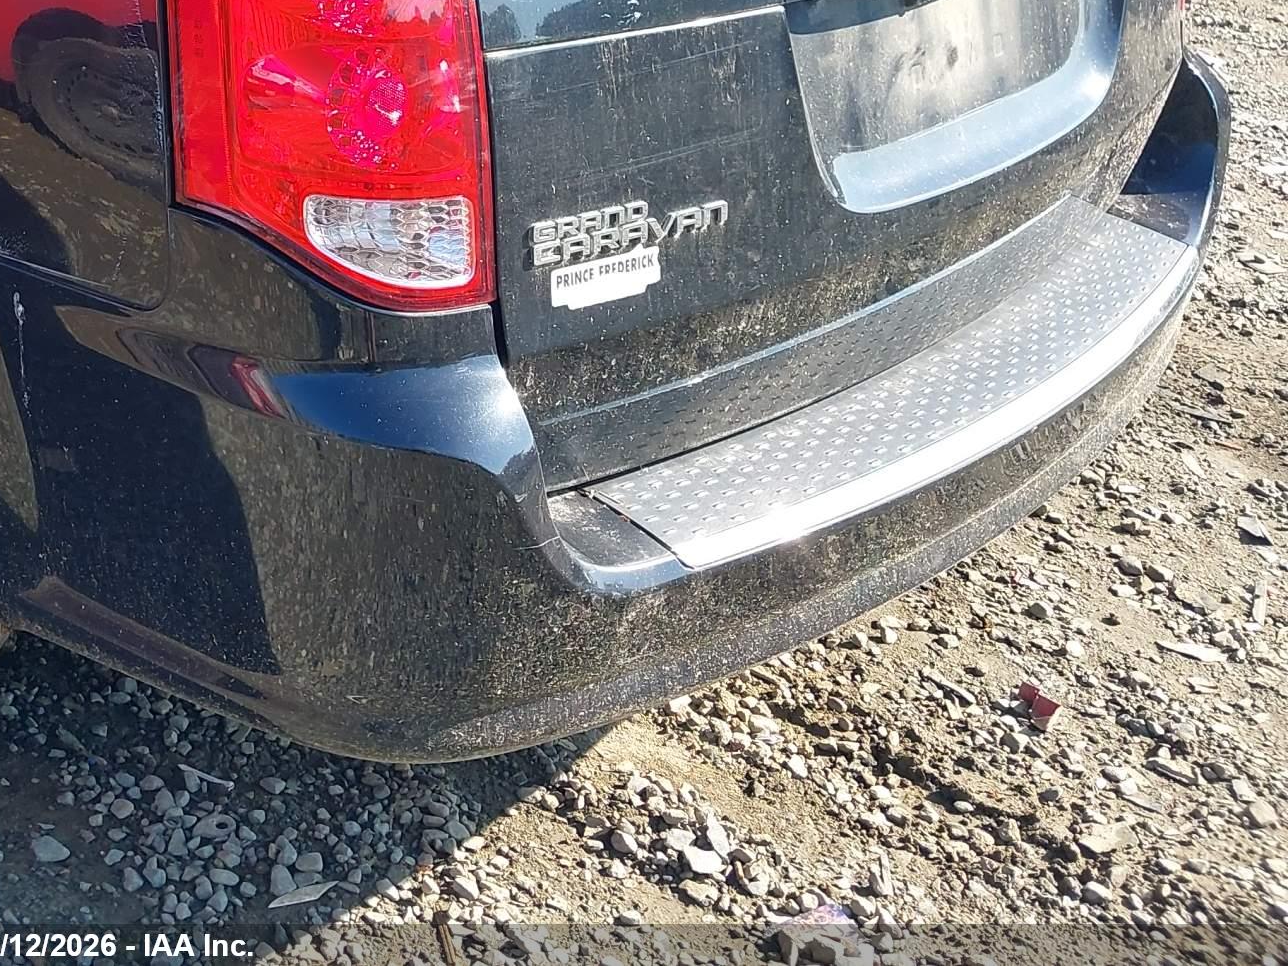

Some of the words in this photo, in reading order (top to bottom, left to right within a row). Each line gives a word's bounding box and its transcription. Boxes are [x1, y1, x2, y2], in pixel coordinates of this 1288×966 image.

[525, 200, 729, 267] CARAVAN
[527, 200, 649, 244] GRAND
[556, 267, 595, 289] PRINCE
[599, 254, 654, 276] FREDERICK
